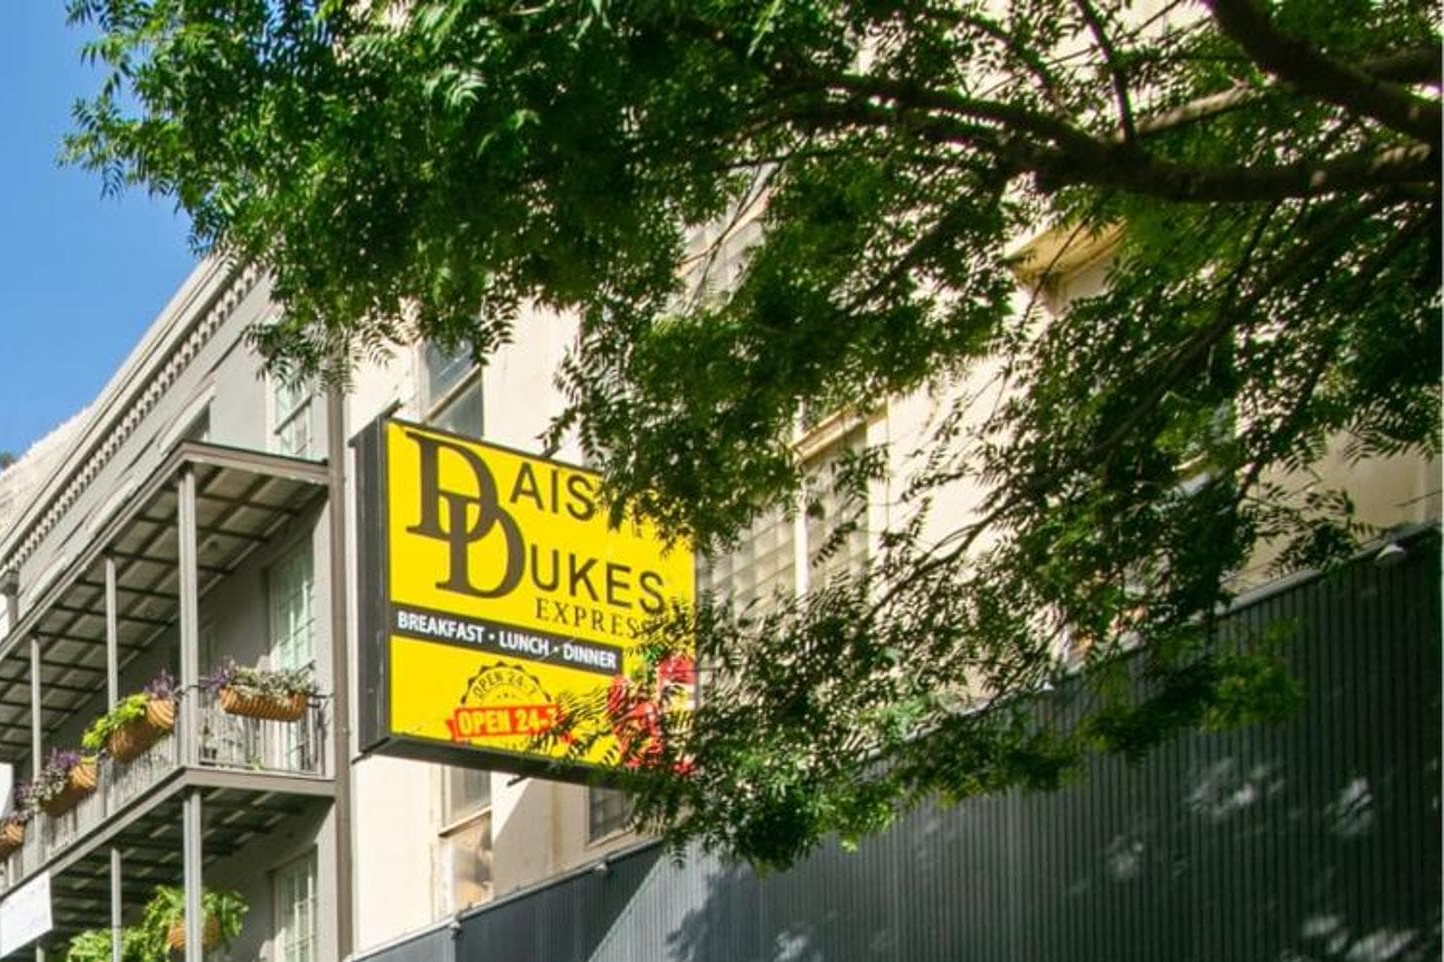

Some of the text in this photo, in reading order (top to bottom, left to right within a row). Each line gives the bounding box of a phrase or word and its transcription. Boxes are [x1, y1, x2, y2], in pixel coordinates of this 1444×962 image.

[406, 431, 620, 543] DAIS
[435, 490, 668, 616] DUKES
[397, 611, 618, 669] BREAKFAST LUNCH DINNER
[472, 670, 505, 698] OPEN
[457, 708, 513, 736] OPEN
